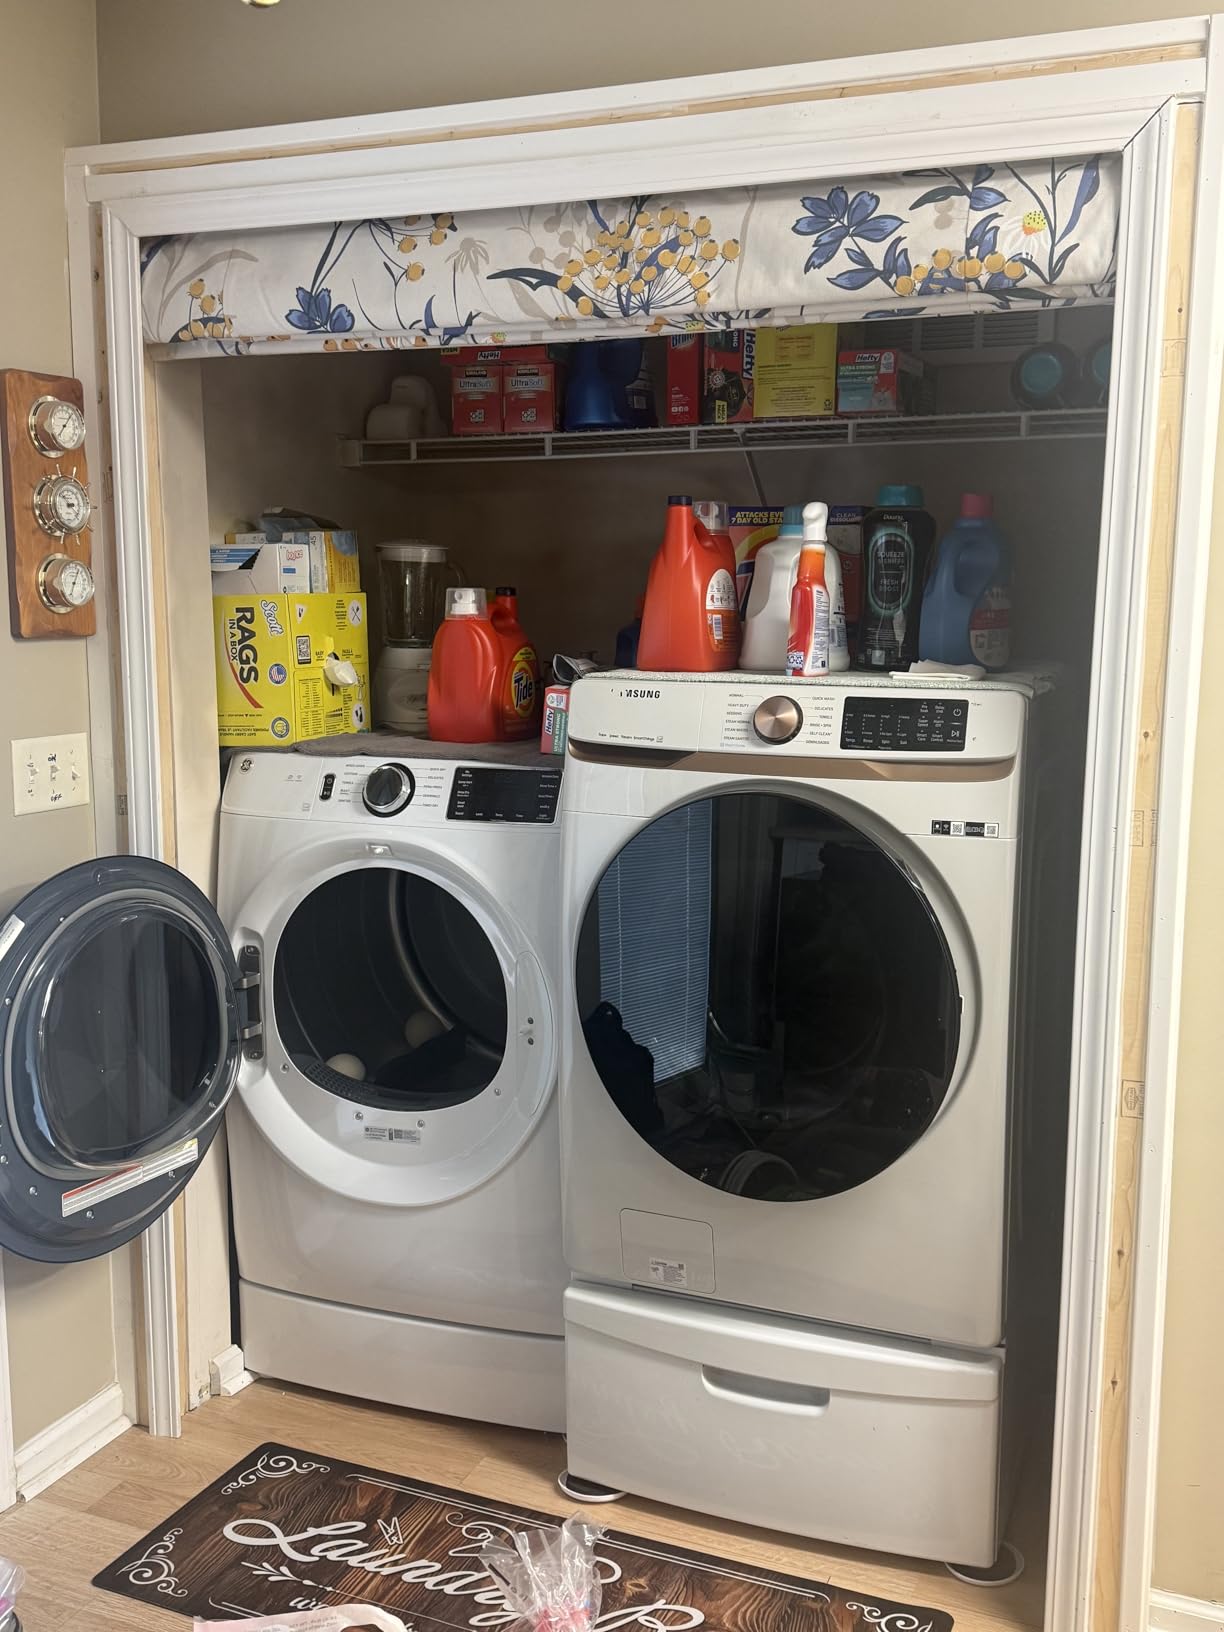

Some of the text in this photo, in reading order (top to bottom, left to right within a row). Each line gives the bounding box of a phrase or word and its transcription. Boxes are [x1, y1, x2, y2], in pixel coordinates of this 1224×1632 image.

[743, 330, 755, 378] Hefty
[856, 353, 880, 362] Hefty
[229, 619, 236, 629] IN
[261, 600, 284, 637] Scott
[230, 640, 238, 661] BOX
[235, 607, 259, 684] RAGS
[514, 676, 533, 708] Tide
[545, 709, 554, 734] Hefty
